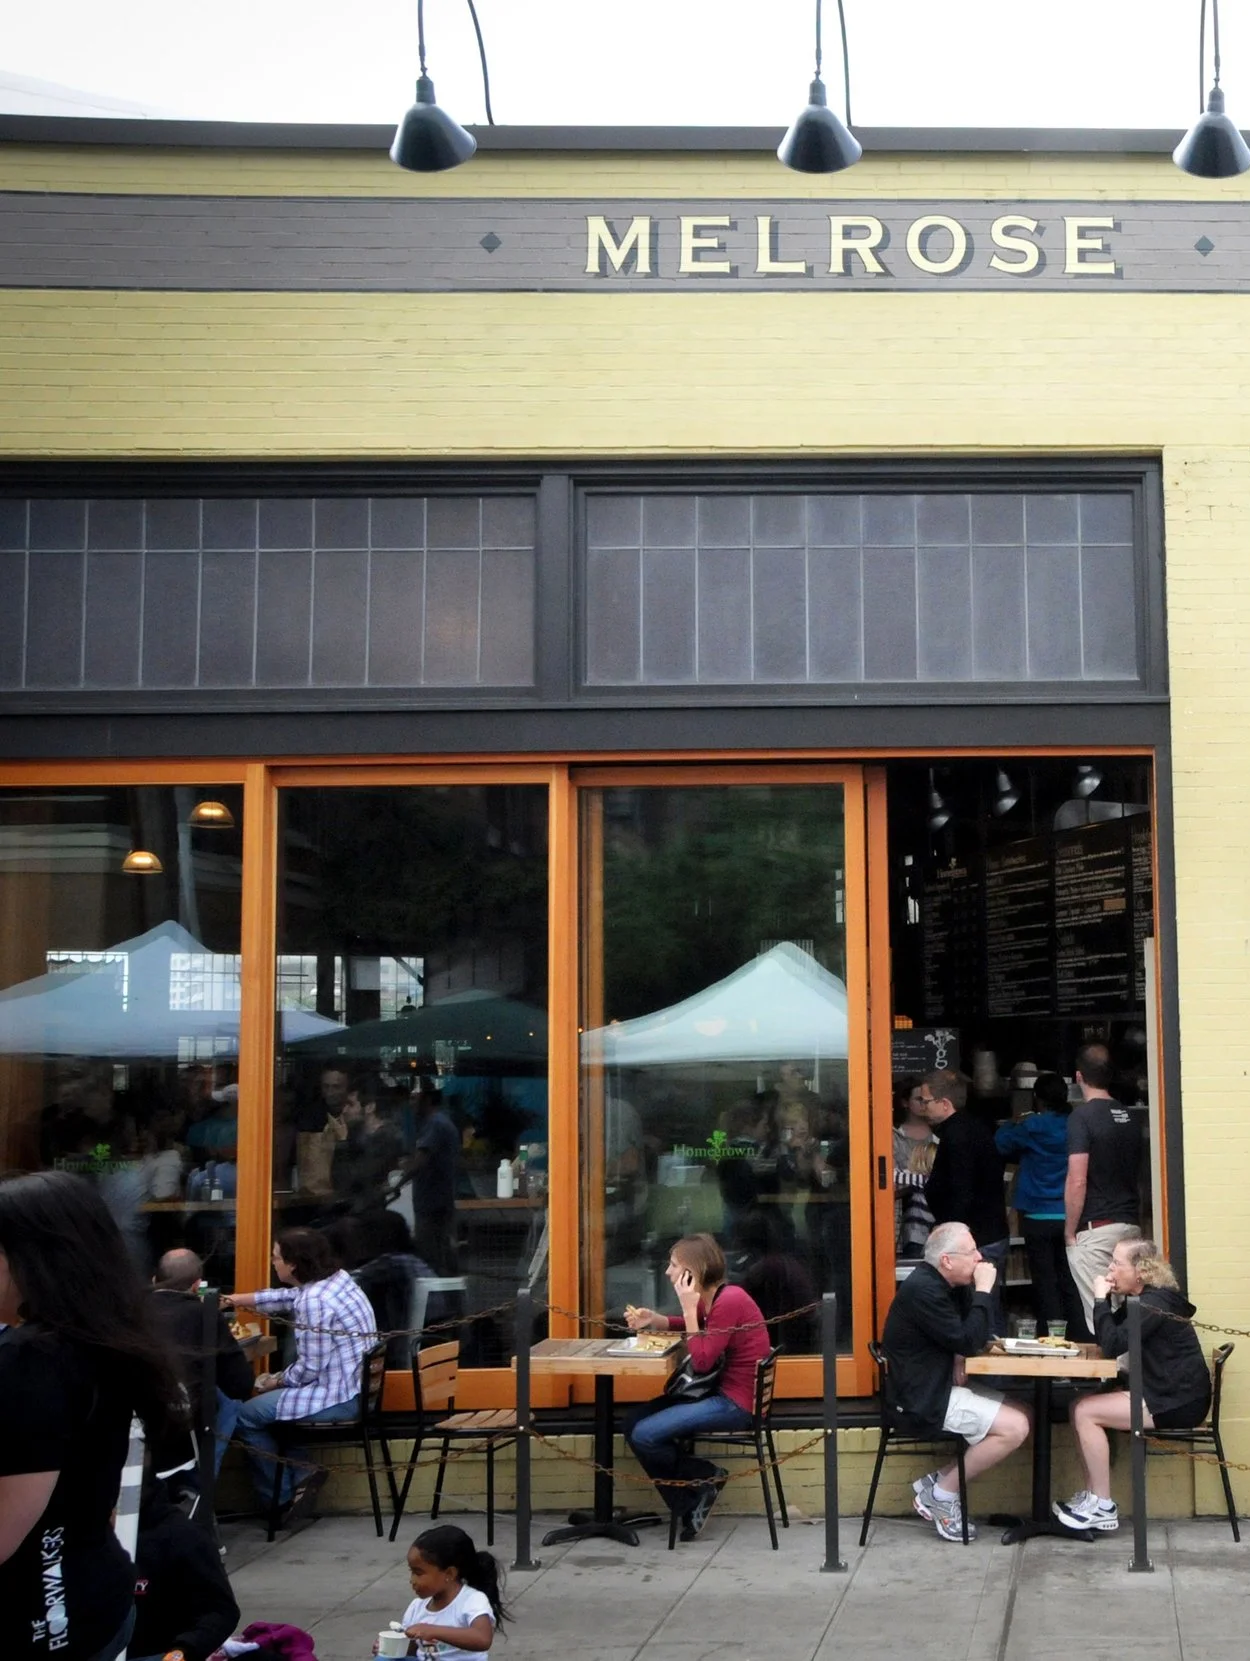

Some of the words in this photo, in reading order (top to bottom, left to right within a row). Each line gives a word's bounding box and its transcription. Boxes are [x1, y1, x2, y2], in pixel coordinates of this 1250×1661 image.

[585, 214, 1119, 277] MELROSE
[673, 1143, 756, 1162] Homegrown
[31, 1618, 47, 1643] THE
